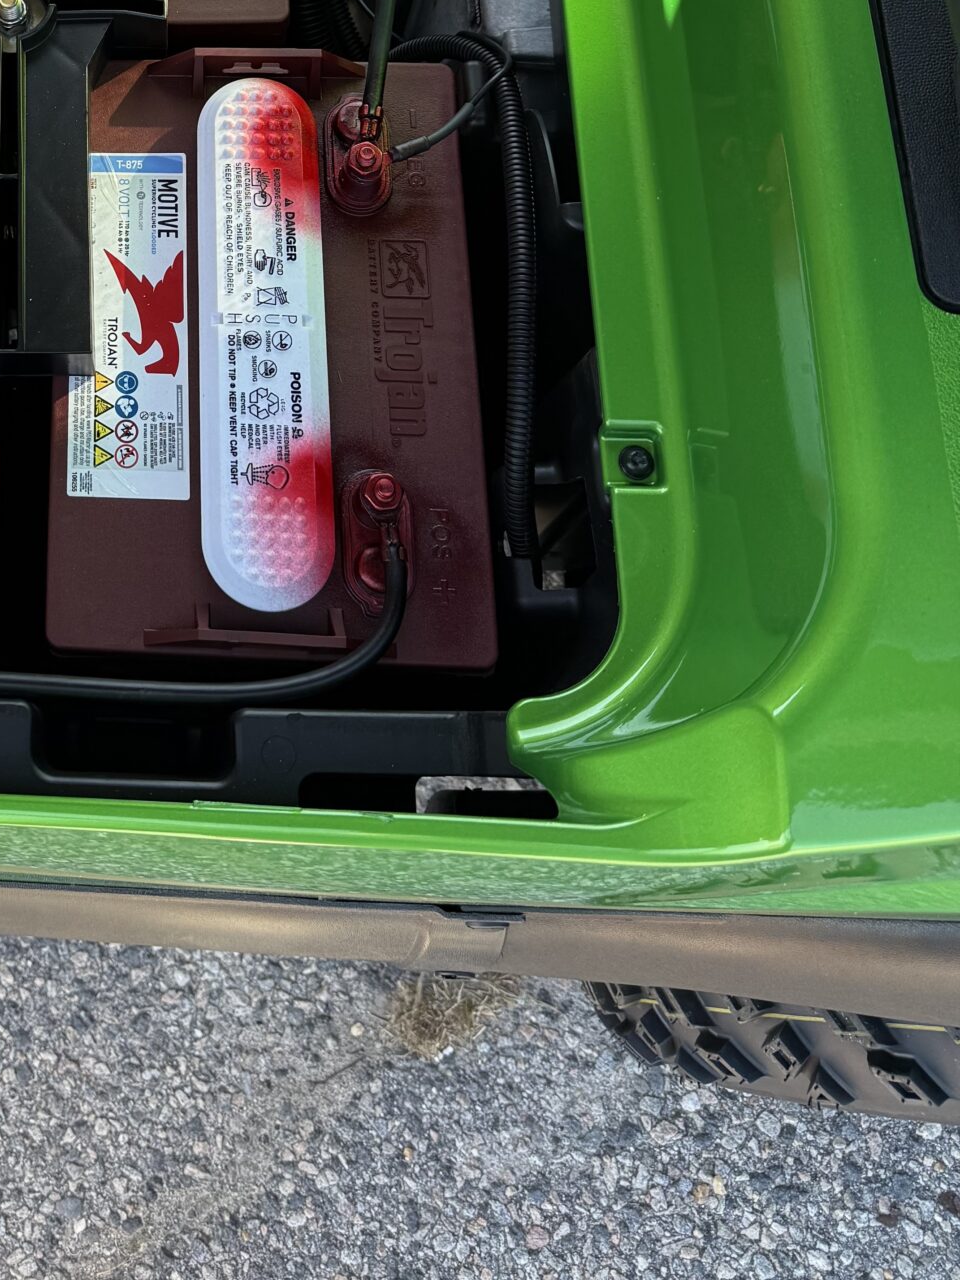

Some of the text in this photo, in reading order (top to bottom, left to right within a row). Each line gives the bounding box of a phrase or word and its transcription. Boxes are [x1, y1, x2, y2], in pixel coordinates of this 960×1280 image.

[116, 160, 143, 169] T-875
[235, 162, 243, 188] SEVERE
[243, 162, 251, 176] CAN
[118, 188, 130, 217] VOLT
[157, 179, 178, 238] MOTIVE
[244, 178, 252, 200] CAUSE
[225, 164, 234, 294] KEEP OUT OF REACH OF CHILDREN
[244, 202, 252, 243] BLINDNESS,
[274, 202, 282, 223] GASES
[275, 227, 283, 257] SULFURIC
[285, 211, 297, 261] DANGER
[227, 313, 298, 324] PUSH
[370, 301, 382, 364] COMPANY
[108, 317, 118, 366] TROJAN
[374, 300, 438, 438] Trojan
[227, 334, 238, 486] DO NOT TIP KEEP VENT CAP TIGHT
[290, 372, 302, 423] POISON
